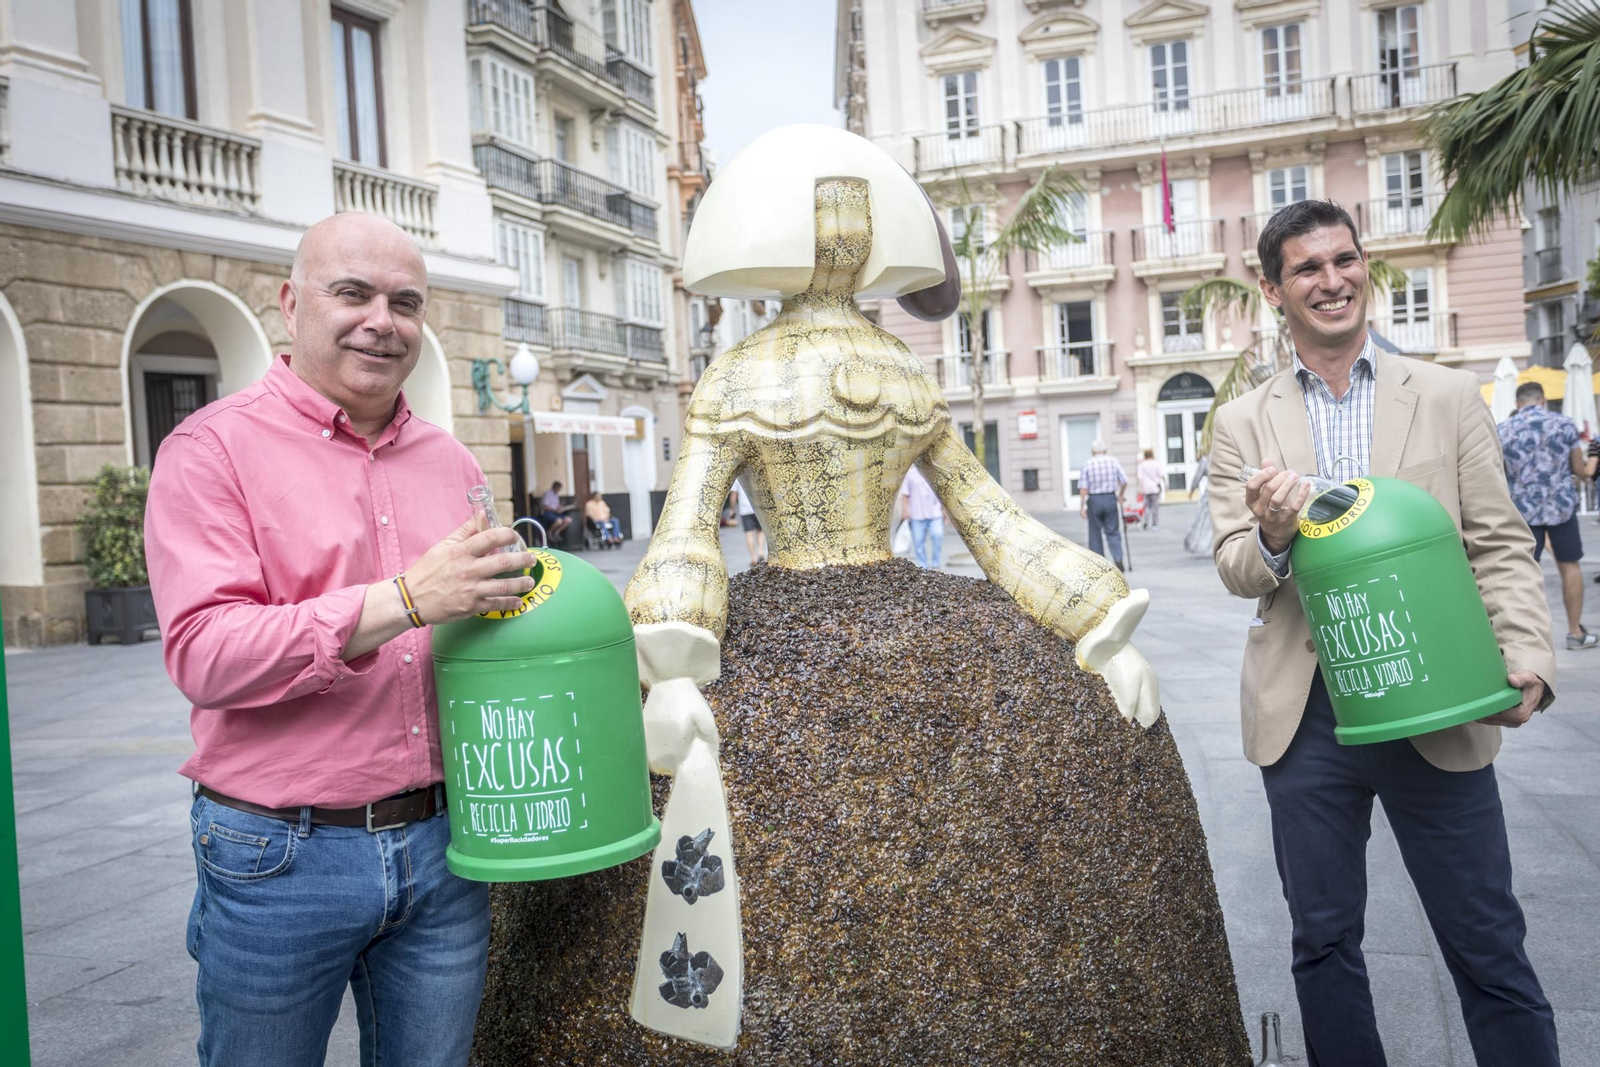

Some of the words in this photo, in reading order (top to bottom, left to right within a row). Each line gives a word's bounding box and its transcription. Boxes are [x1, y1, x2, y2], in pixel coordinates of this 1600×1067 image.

[1327, 498, 1367, 533] VIDRIO
[1325, 593, 1346, 621] NO
[1344, 591, 1371, 618] HAY
[1320, 609, 1406, 662] EXCUSAS
[1334, 666, 1373, 693] RECICLA
[1372, 657, 1414, 687] VIDRIO
[480, 704, 504, 740] NO
[506, 705, 535, 740] HAY
[461, 736, 570, 791] EXCUSAS
[469, 802, 518, 833] RECICLA
[524, 796, 572, 831] VIDRIO
[489, 835, 550, 846] #SuperRecicladores
